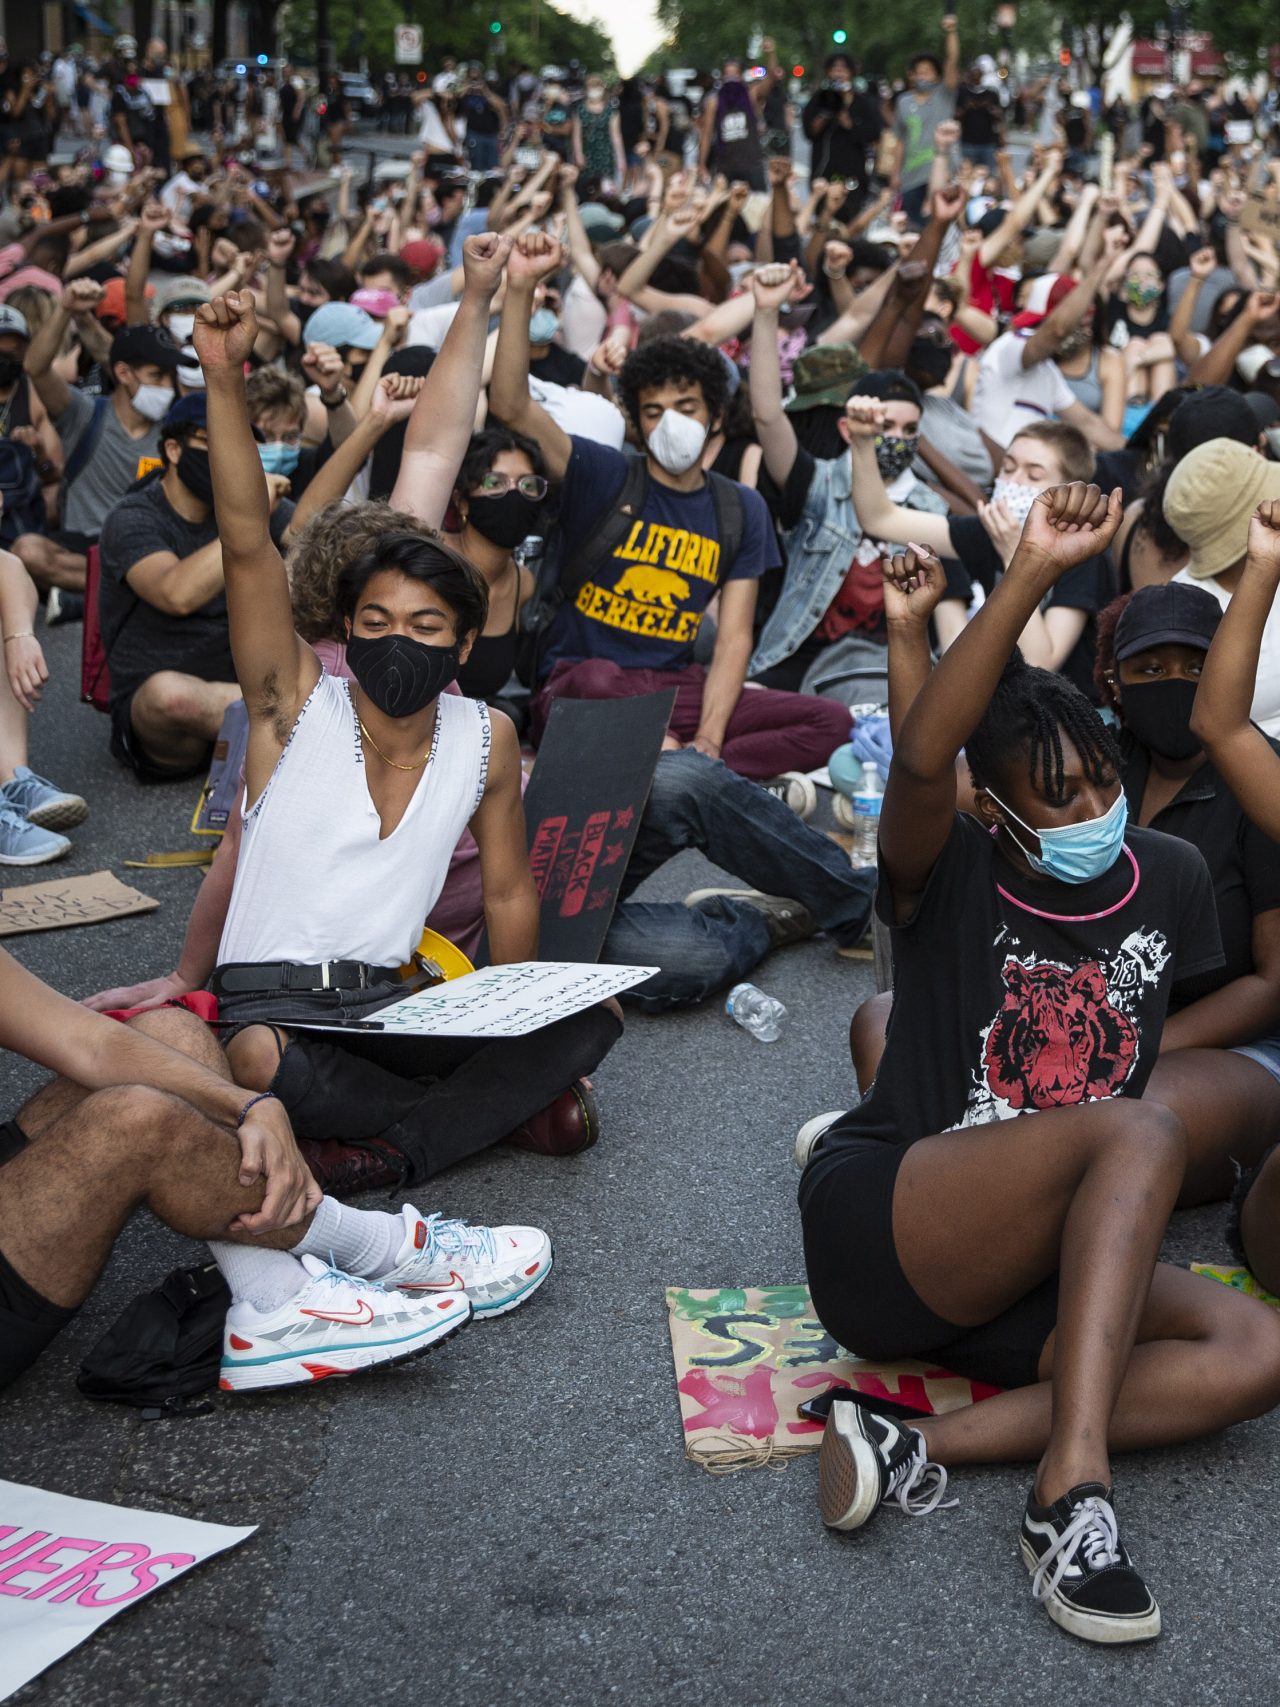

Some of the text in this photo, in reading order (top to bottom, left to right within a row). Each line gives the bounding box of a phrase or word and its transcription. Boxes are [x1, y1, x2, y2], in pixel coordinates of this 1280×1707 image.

[481, 724, 491, 748] NO
[568, 822, 607, 893] BLACK
[496, 966, 553, 983] We
[593, 971, 650, 996] Across
[1110, 956, 1136, 987] 18
[381, 967, 537, 1024] THE WHOL
[442, 987, 503, 1008] need
[472, 974, 602, 1032] more police
[556, 980, 612, 1006] protests
